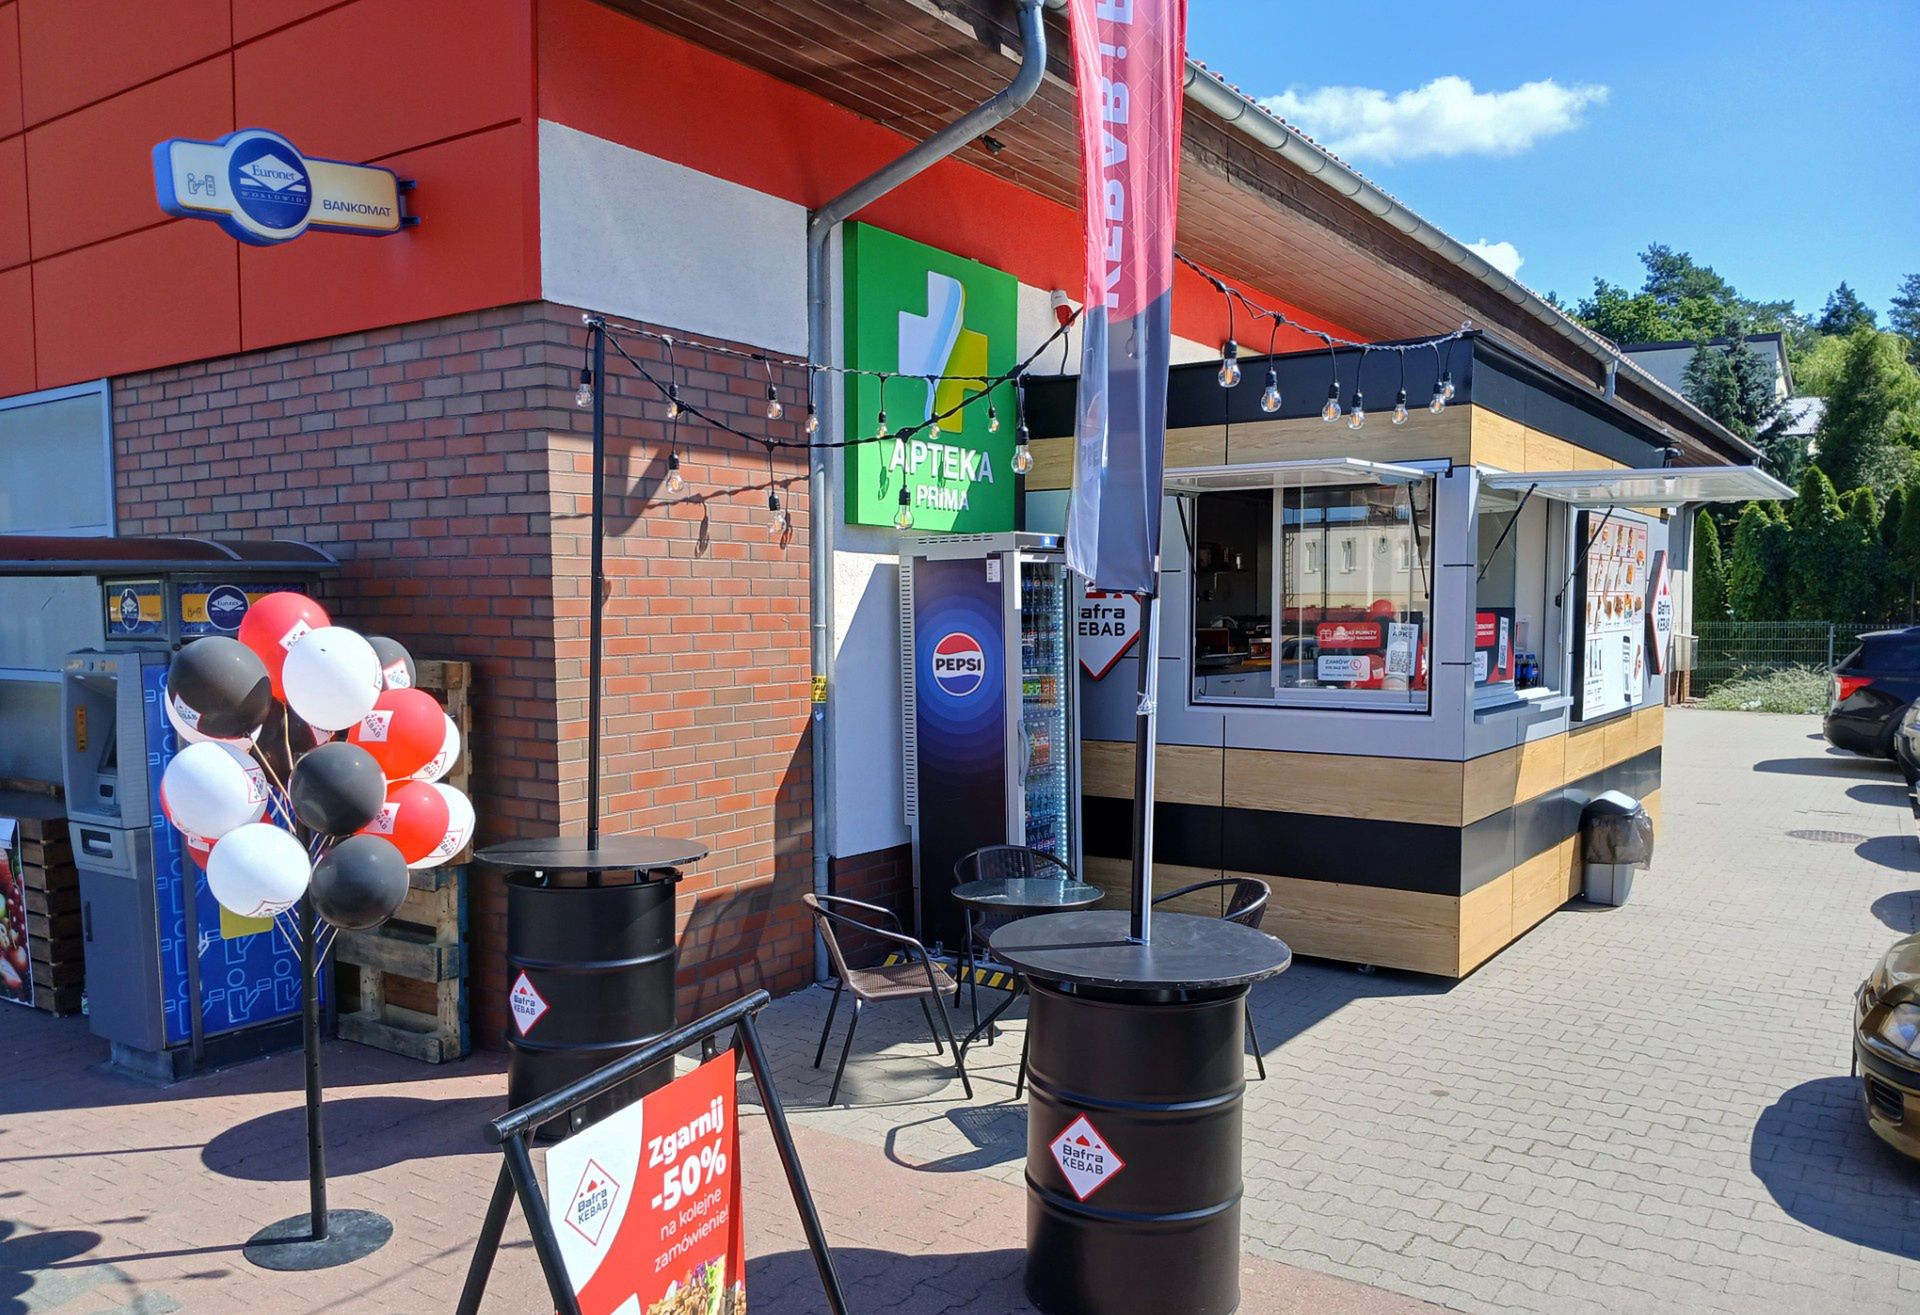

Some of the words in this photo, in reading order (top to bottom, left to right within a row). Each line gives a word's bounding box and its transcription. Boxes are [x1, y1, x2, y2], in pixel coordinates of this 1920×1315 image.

[252, 164, 296, 181] Euronet
[323, 199, 391, 217] BANKOMAT
[888, 438, 994, 484] APTEKA
[916, 484, 970, 511] PRIMA
[1078, 603, 1126, 619] afra
[935, 657, 982, 671] PEPSI
[513, 1002, 536, 1016] KEBAB
[647, 1095, 725, 1169] Zgarnij
[1062, 1156, 1104, 1175] KEBAB
[1063, 1144, 1104, 1163] Bafra
[651, 1137, 727, 1211] -50%
[577, 1188, 608, 1213] Bafra
[578, 1198, 609, 1225] KEBAB
[660, 1221, 677, 1241] na
[679, 1188, 722, 1226] kolejne
[654, 1204, 730, 1274] zamówienie!
